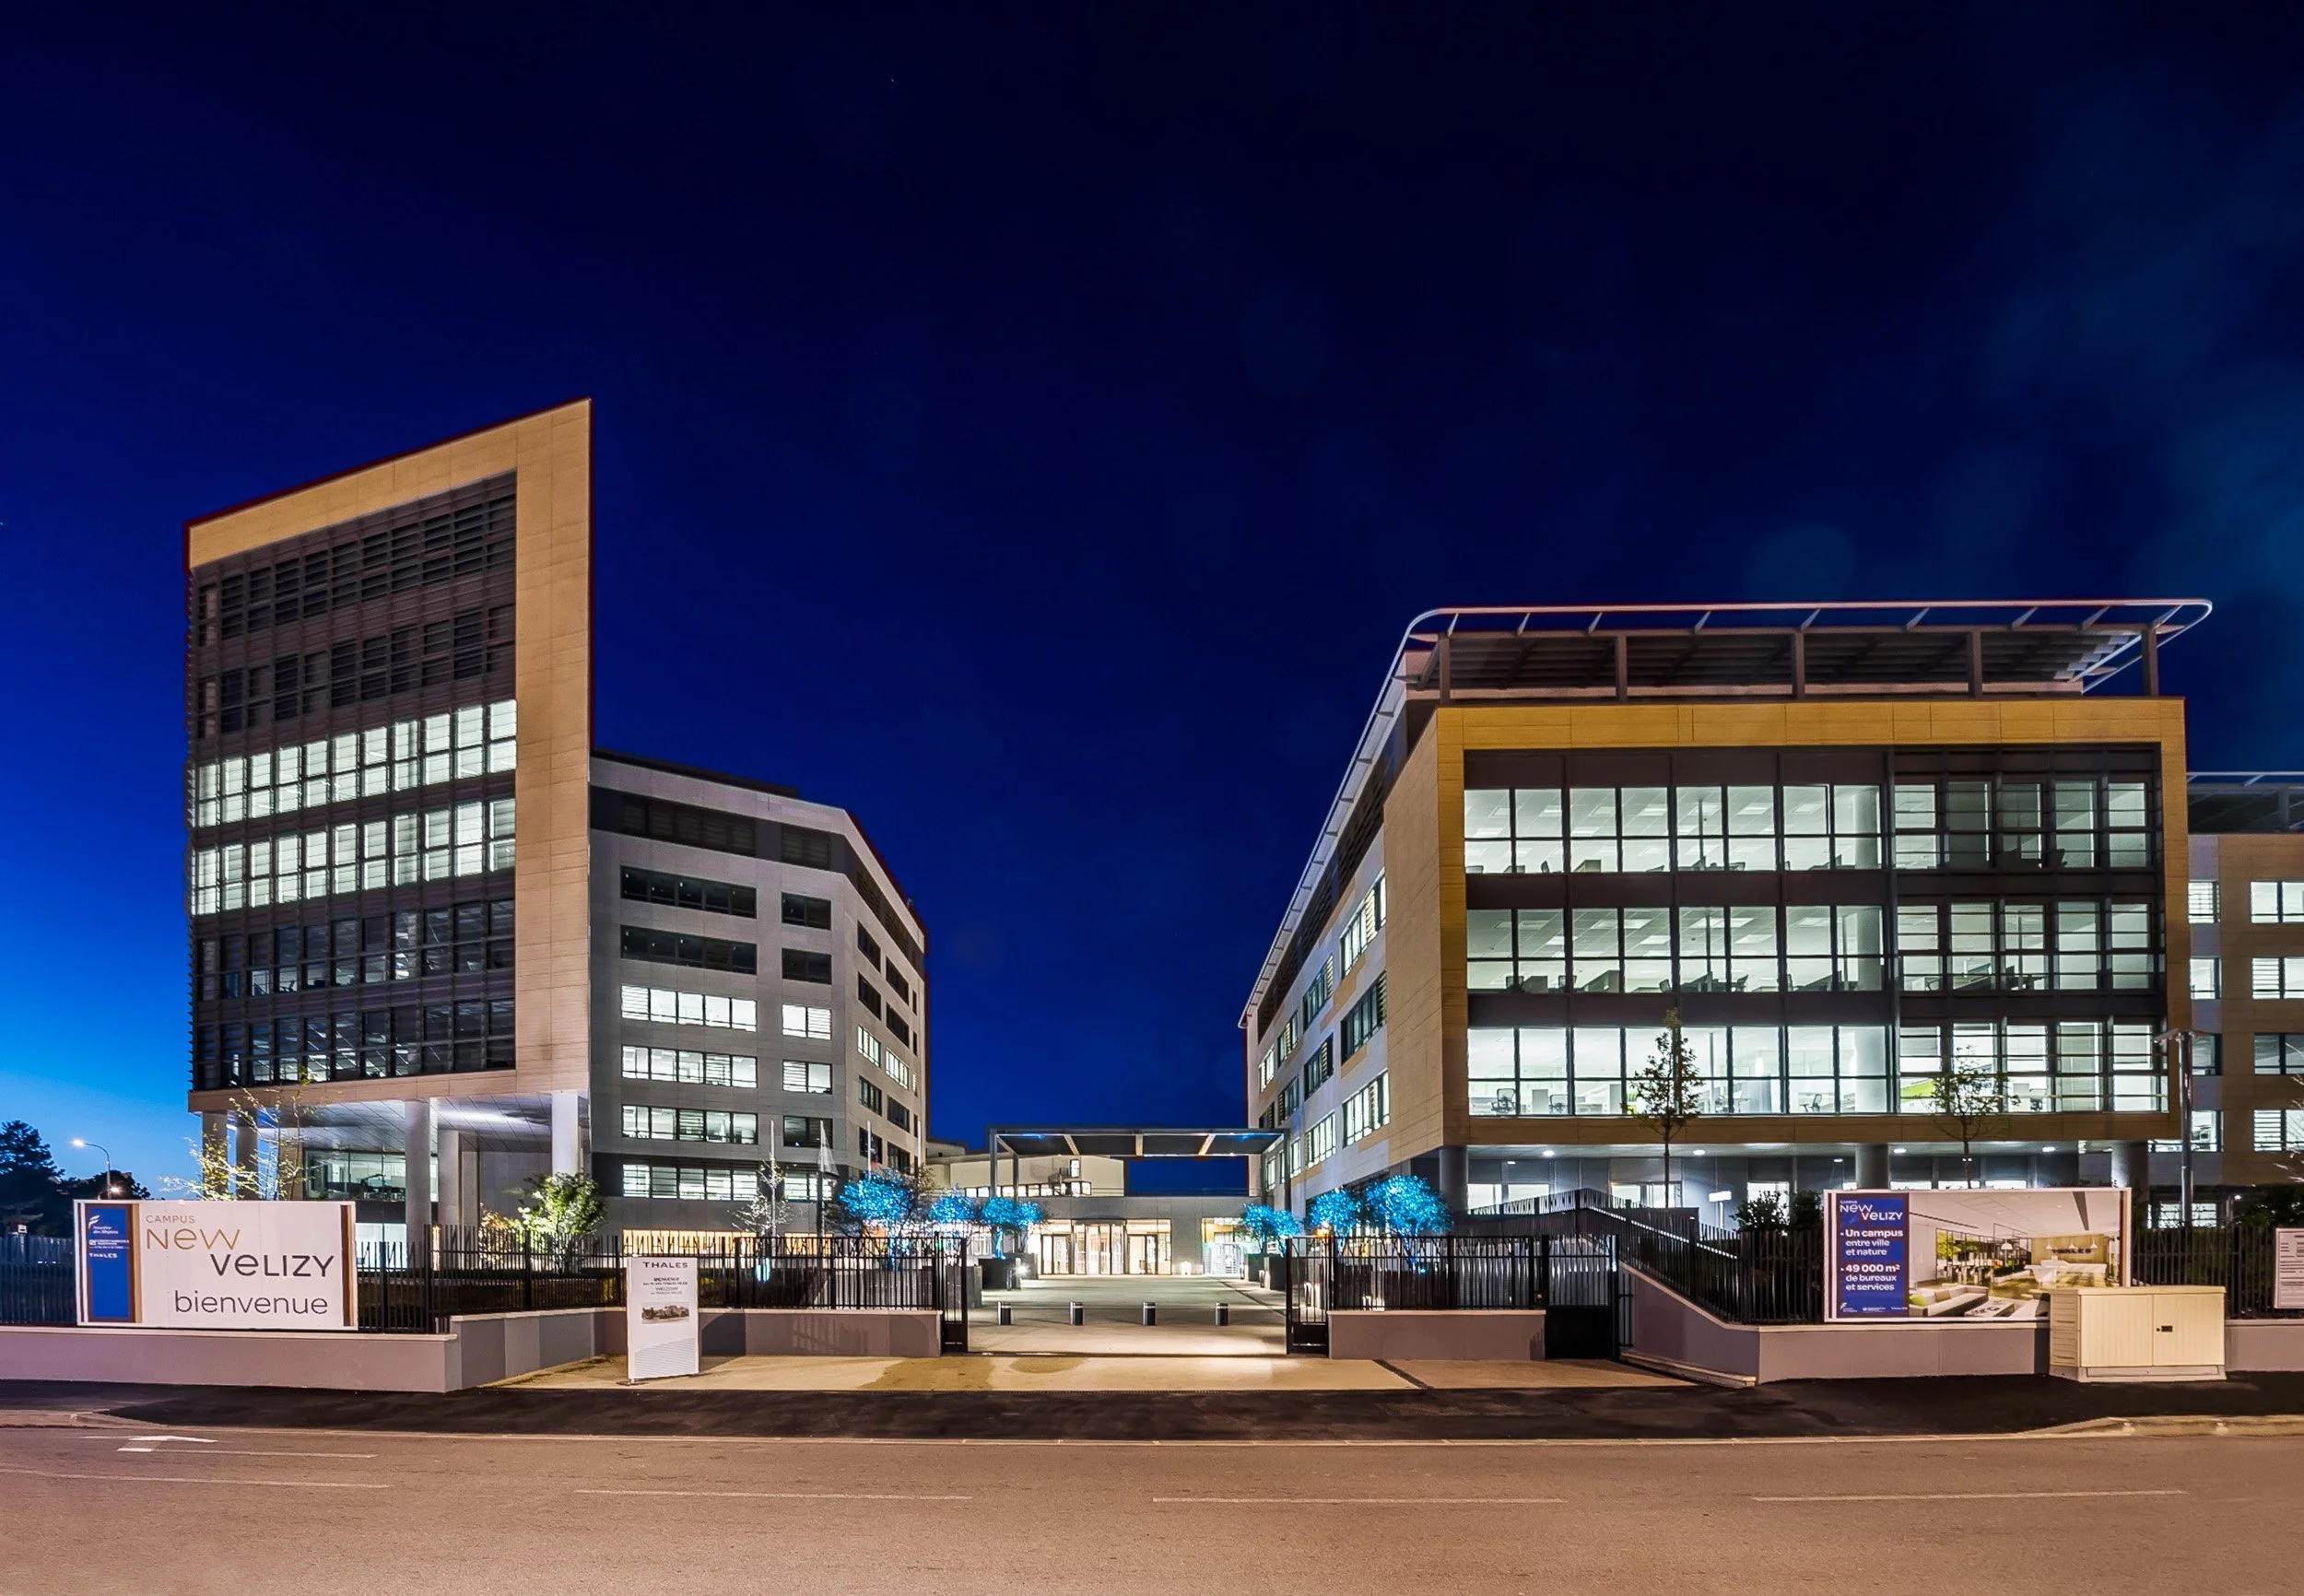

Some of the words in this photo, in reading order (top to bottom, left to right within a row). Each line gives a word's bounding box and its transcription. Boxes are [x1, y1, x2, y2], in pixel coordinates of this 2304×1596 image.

[146, 1215, 195, 1224] CAMPUS
[1862, 1229, 1904, 1238] campus
[1871, 1238, 1890, 1247] ville
[1845, 1263, 1860, 1273] 49
[1861, 1263, 1885, 1273] 000
[1856, 1283, 1895, 1291] services
[175, 1290, 328, 1314] bienvenue
